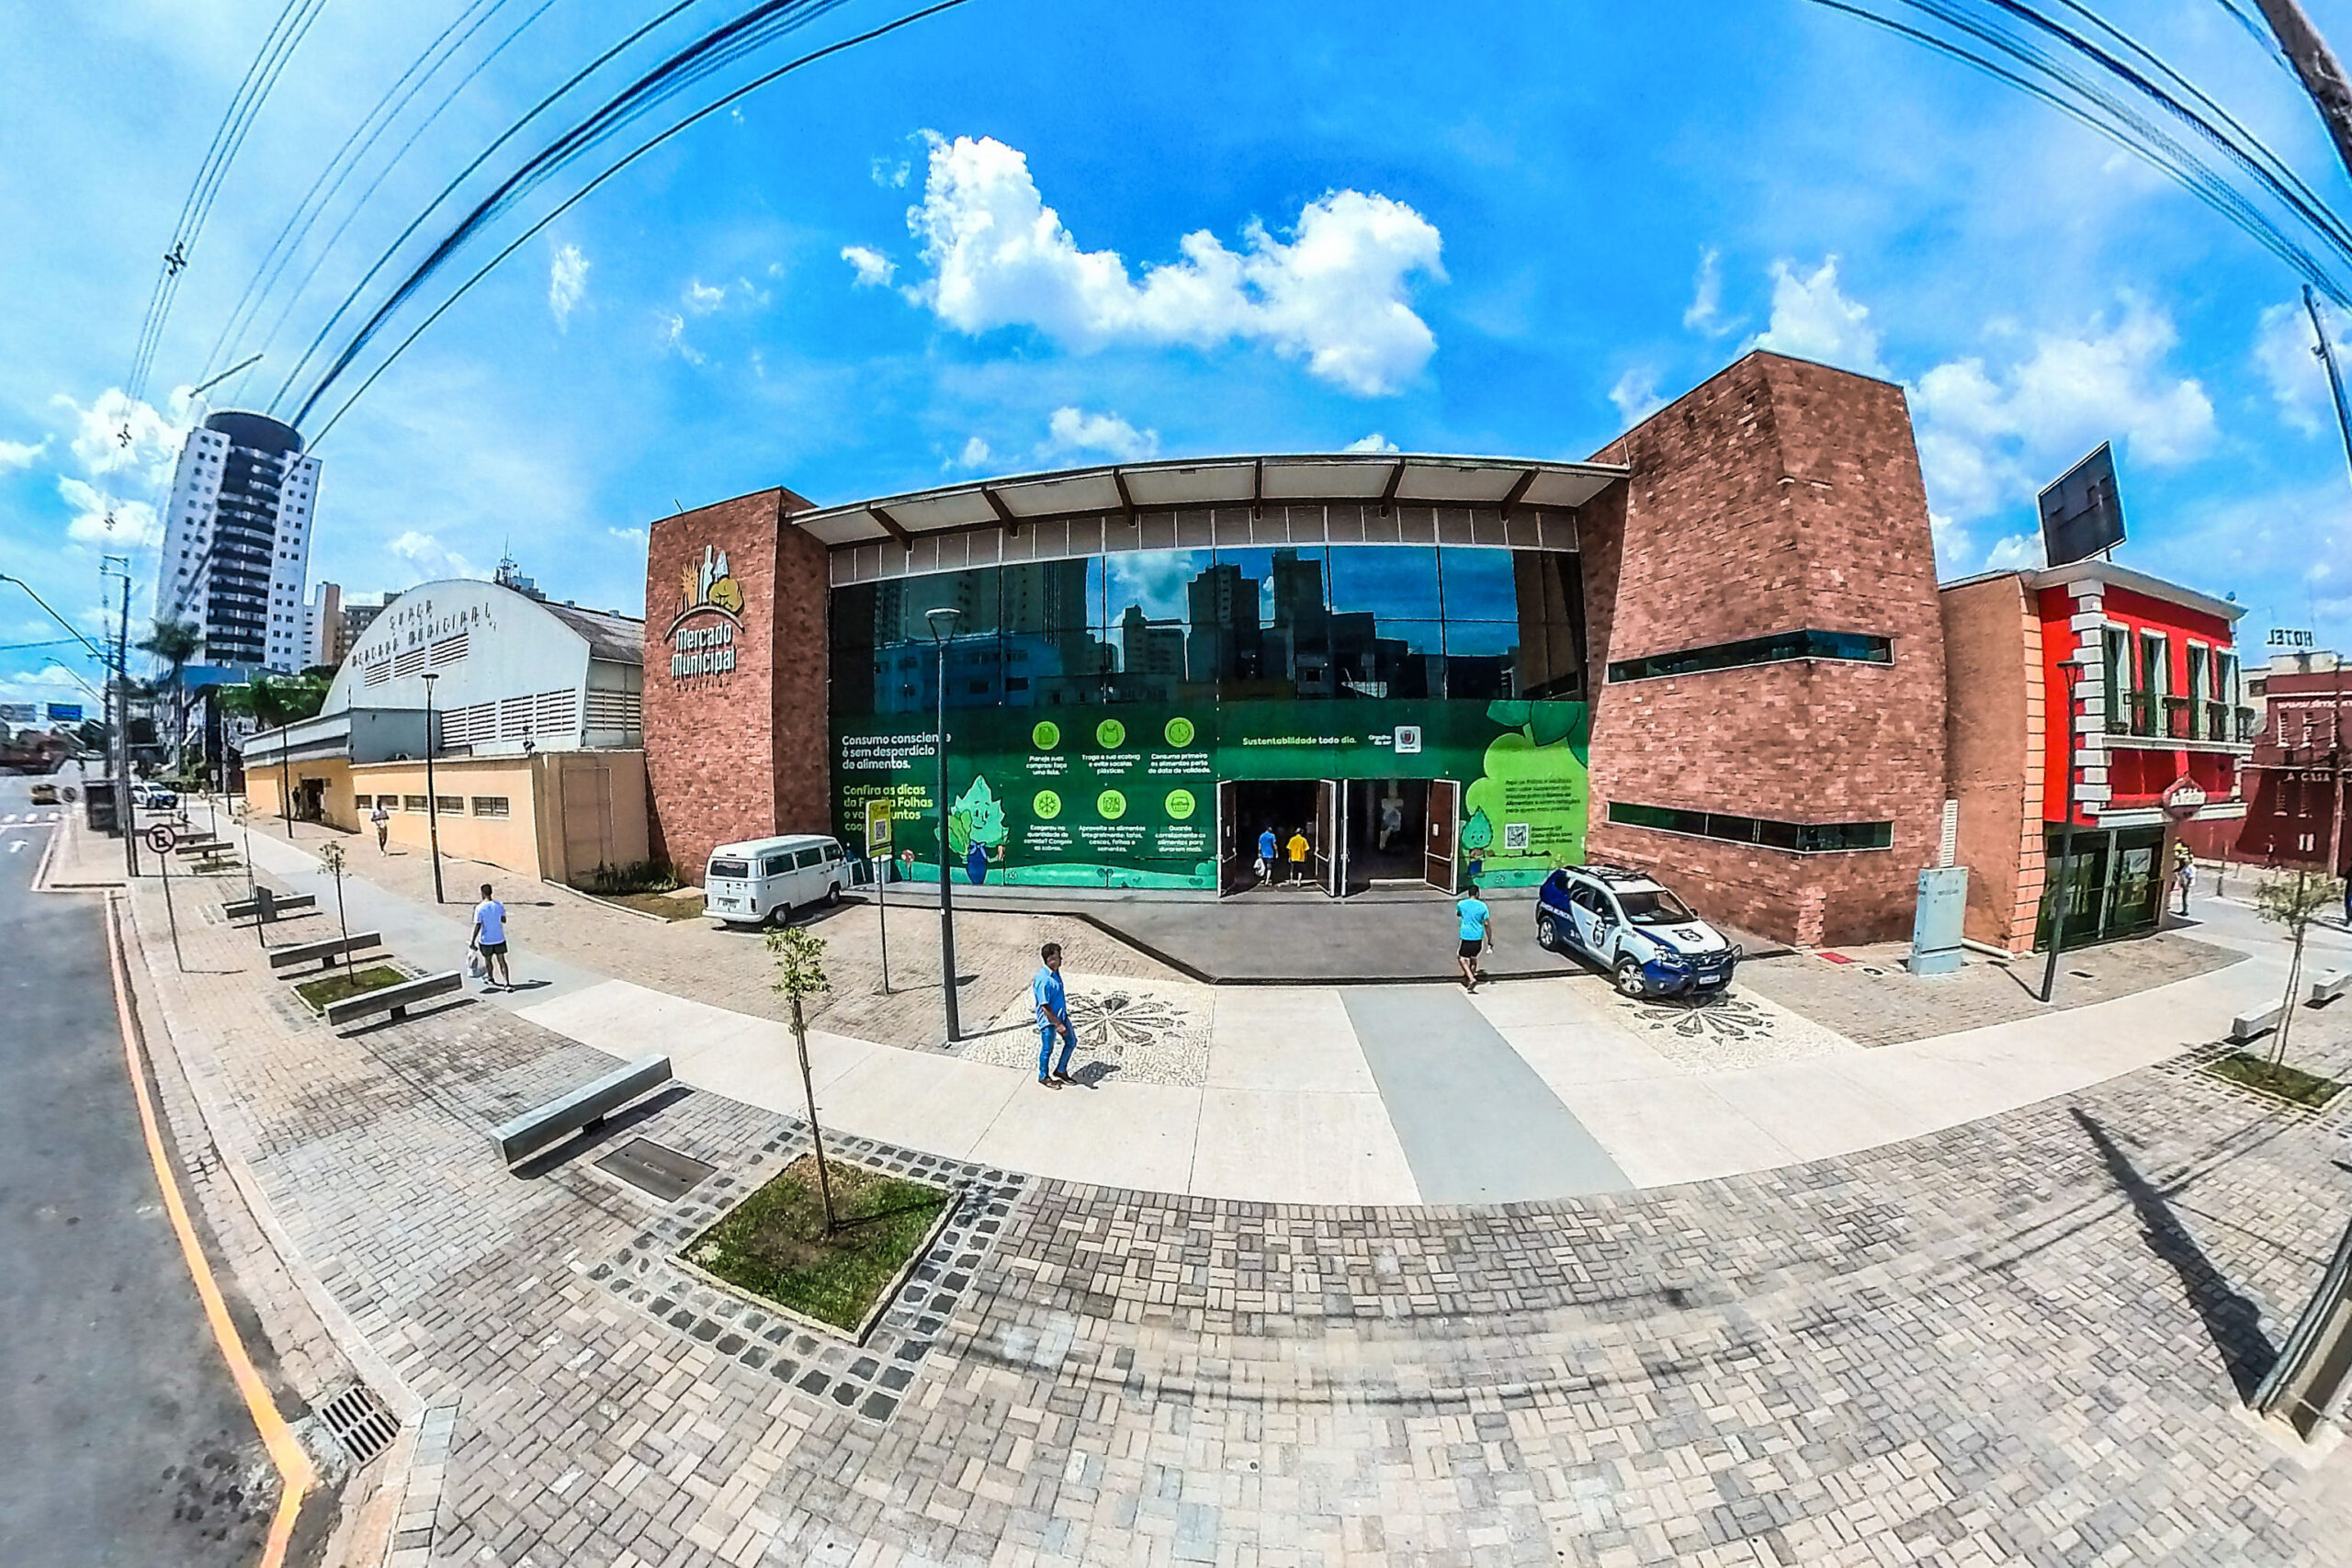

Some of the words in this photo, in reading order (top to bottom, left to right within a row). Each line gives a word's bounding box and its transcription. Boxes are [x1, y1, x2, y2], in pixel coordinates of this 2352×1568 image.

[842, 735, 889, 746] Consumo
[890, 731, 952, 745] consciene
[1242, 736, 1317, 746] Sustentabilidade
[1317, 736, 1340, 745] todo
[1340, 736, 1357, 744] dia.
[850, 749, 872, 758] sem
[842, 759, 855, 770] de
[856, 758, 911, 770] alimentos.
[842, 784, 882, 795] Confira
[882, 786, 896, 795] as
[896, 784, 926, 795] dicas
[897, 795, 933, 808] Folhas
[890, 808, 922, 820] untos
